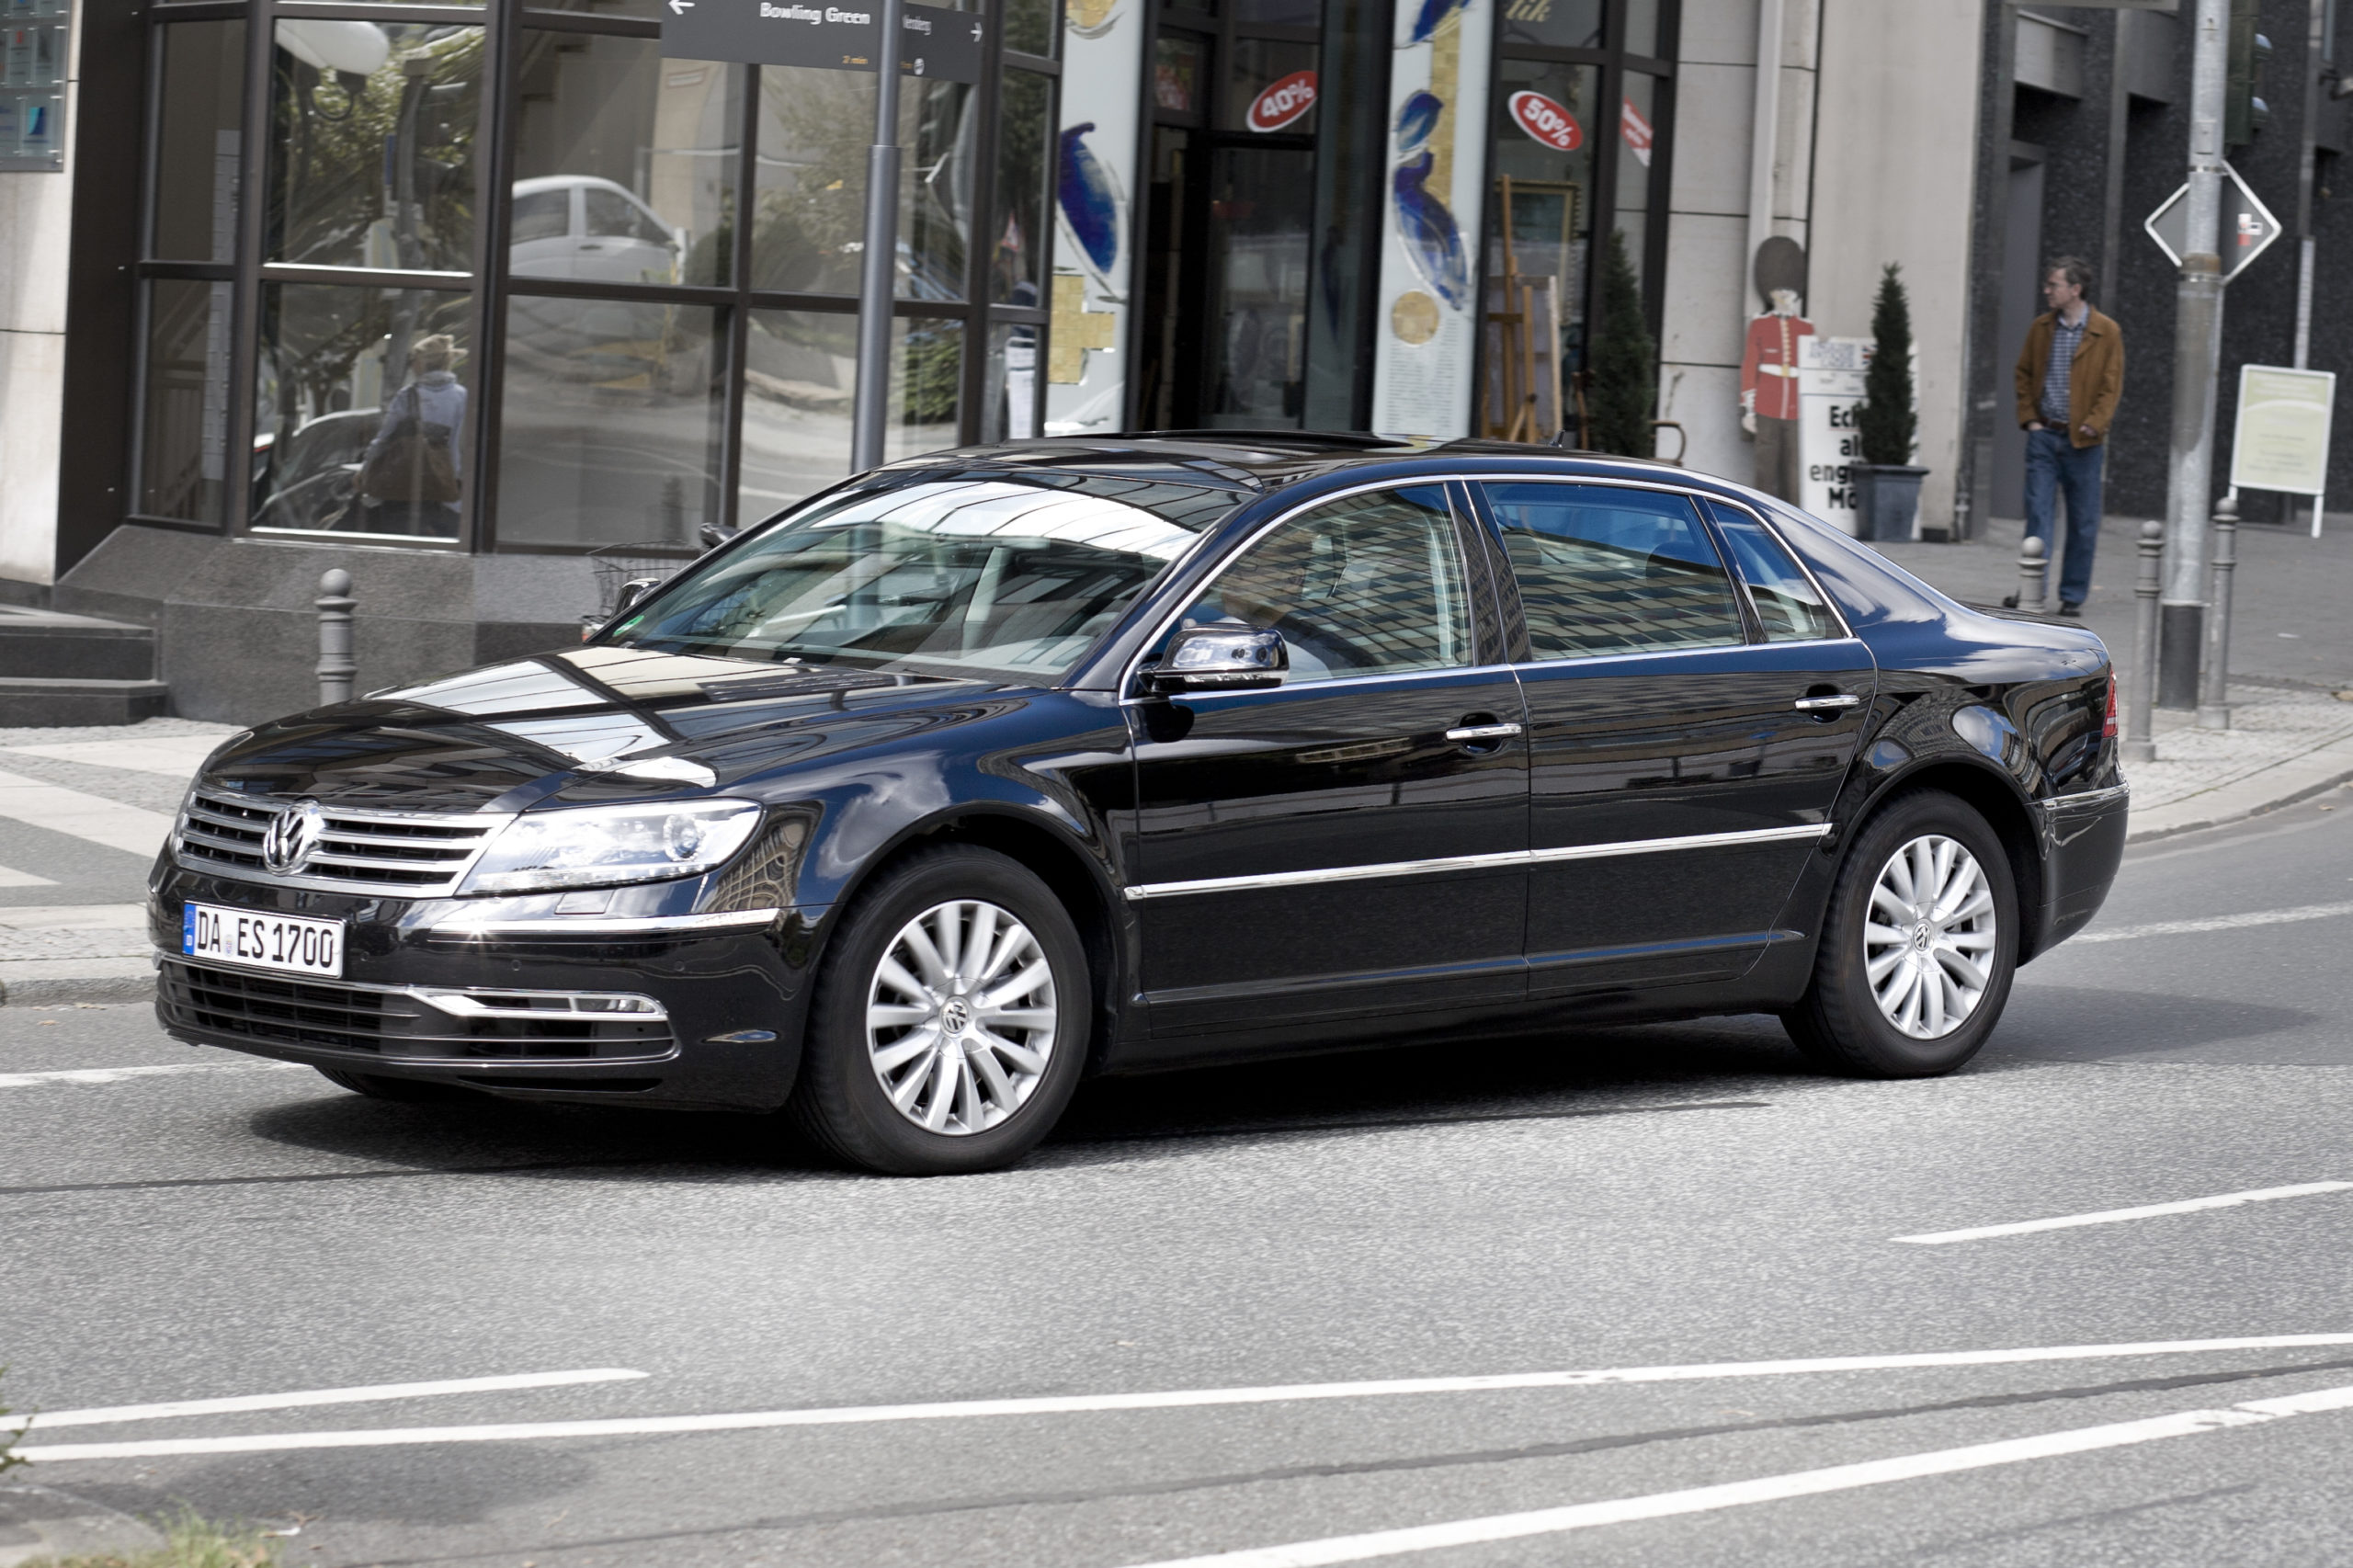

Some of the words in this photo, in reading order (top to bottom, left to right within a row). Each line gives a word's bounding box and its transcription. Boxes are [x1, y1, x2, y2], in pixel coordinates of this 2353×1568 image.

[759, 2, 822, 25] Bowling
[825, 6, 870, 24] Green
[1261, 79, 1314, 117] 40%
[1523, 98, 1573, 146] 50%
[198, 911, 221, 953] DA
[237, 917, 265, 959] ES
[272, 923, 333, 968] 1700
